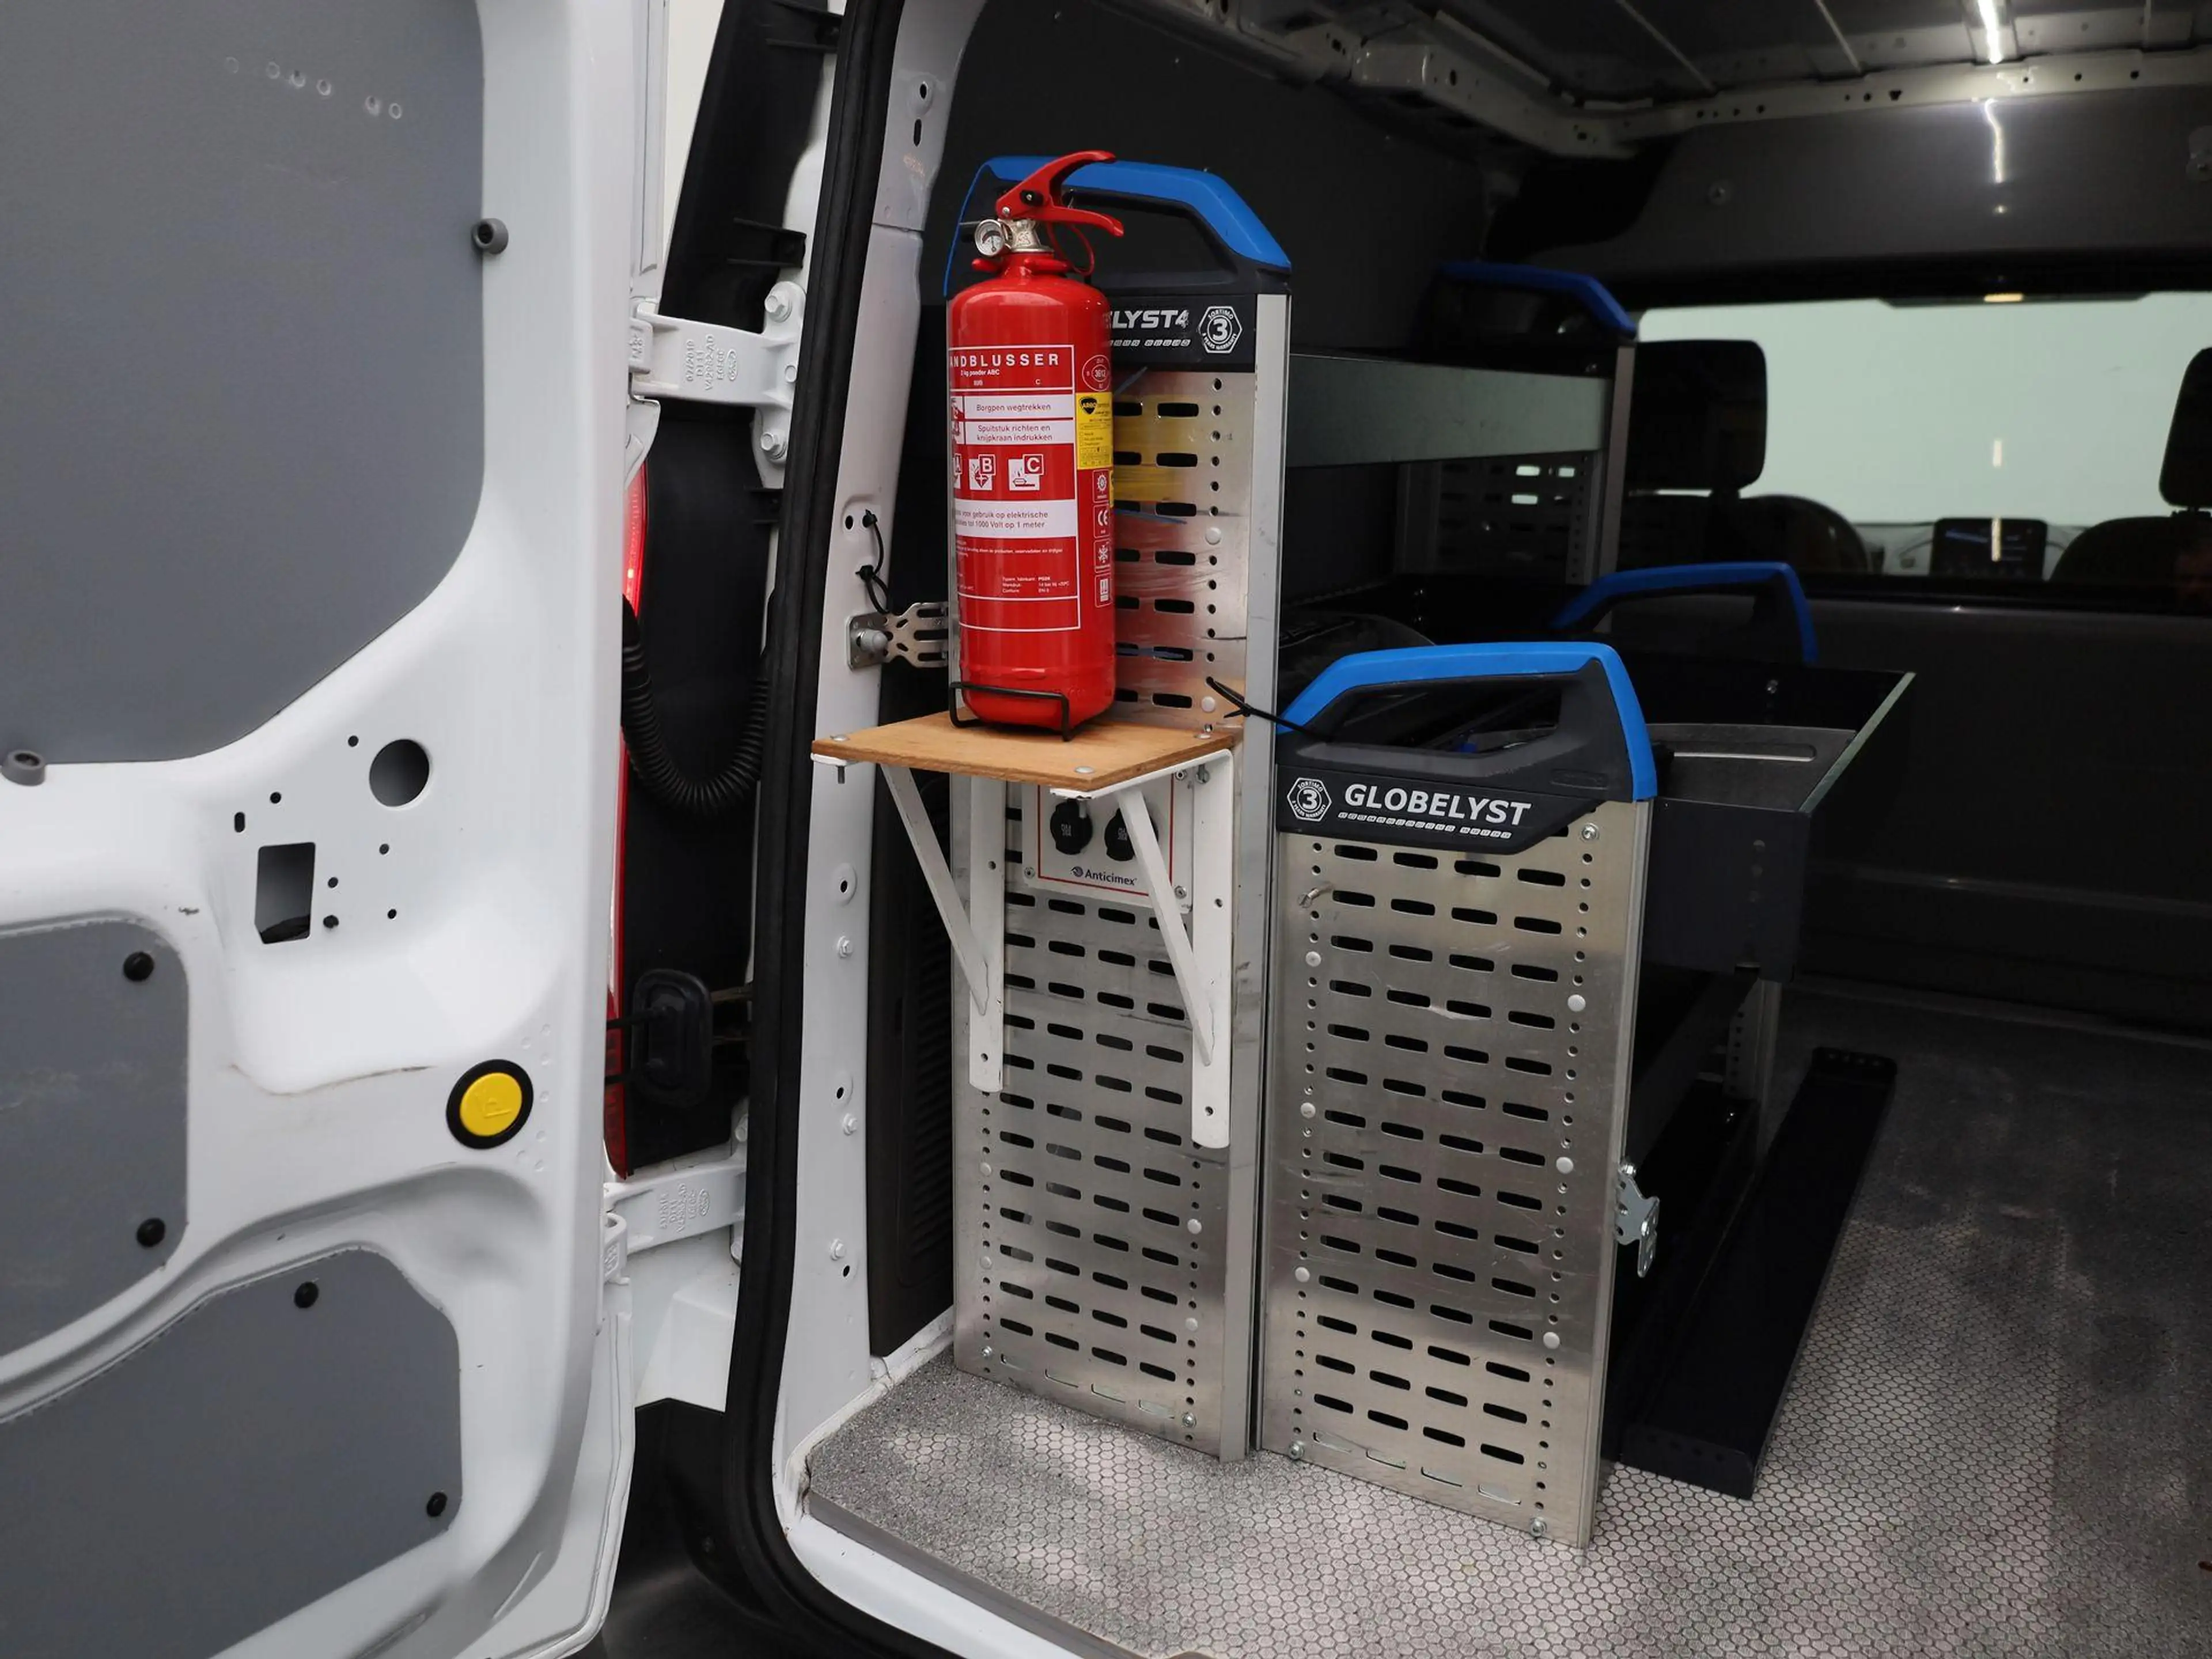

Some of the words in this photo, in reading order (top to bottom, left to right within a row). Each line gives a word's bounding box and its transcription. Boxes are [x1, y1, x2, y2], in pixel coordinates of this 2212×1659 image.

[1109, 310, 1189, 329] LYST4
[1213, 318, 1228, 341] 3
[976, 404, 1005, 412] Borgpen
[1007, 403, 1051, 412] wegtrekken
[978, 425, 1009, 433] Spuitstuk
[977, 434, 1012, 442] knijpkraan
[982, 458, 993, 472] B
[1027, 459, 1040, 472] C
[972, 511, 994, 519] gebruik
[1302, 789, 1317, 810] 3
[1344, 783, 1532, 825] GLOBELYST
[1085, 869, 1135, 885] Anticimex
